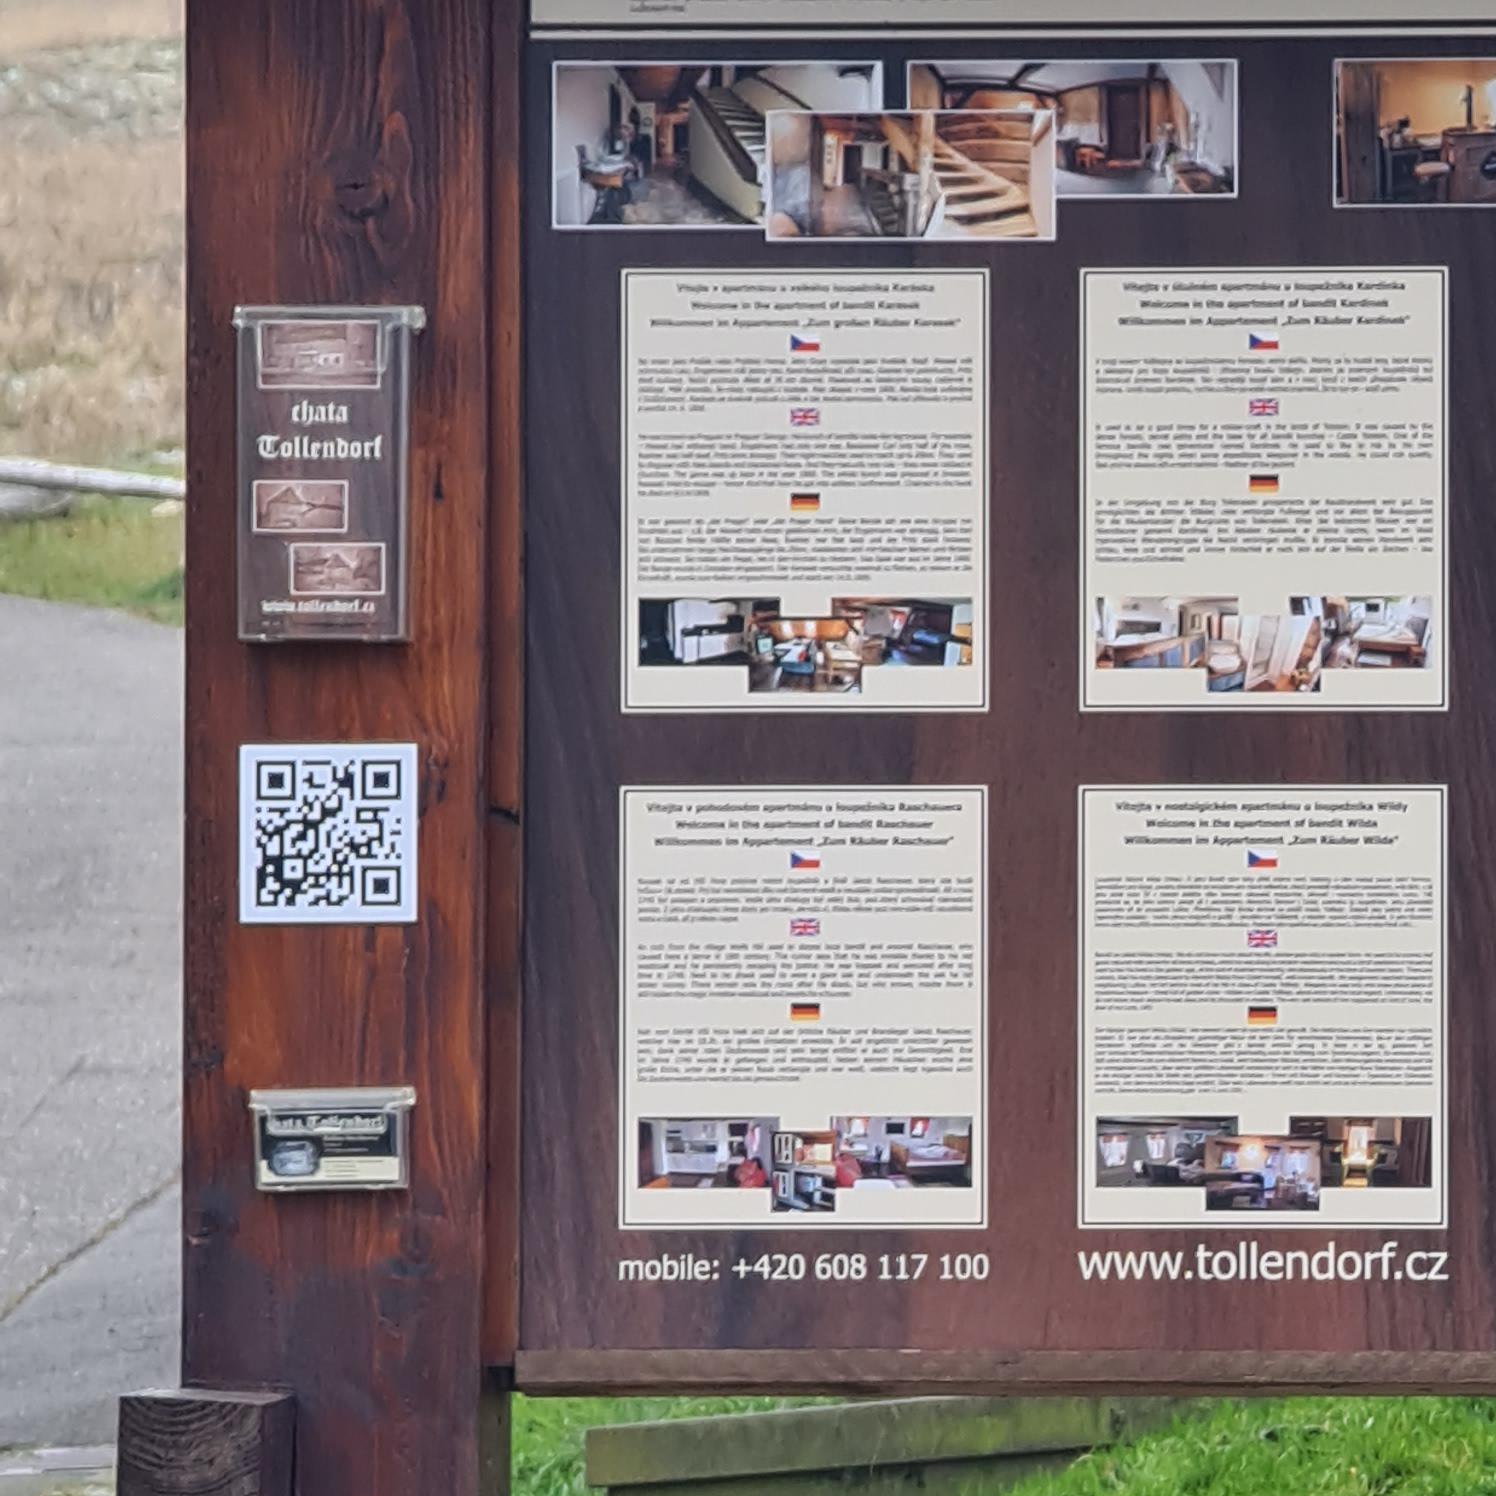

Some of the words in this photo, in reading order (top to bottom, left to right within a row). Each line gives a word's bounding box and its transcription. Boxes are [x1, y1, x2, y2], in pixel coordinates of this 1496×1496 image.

[291, 399, 348, 426] chata
[256, 434, 382, 459] Tollendorf
[618, 1253, 720, 1281] mobile:
[731, 1253, 806, 1281] +420
[814, 1253, 867, 1281] 608
[878, 1253, 928, 1281] 117
[938, 1253, 990, 1281] 100
[1077, 1241, 1450, 1281] www.tollendorf.cz
